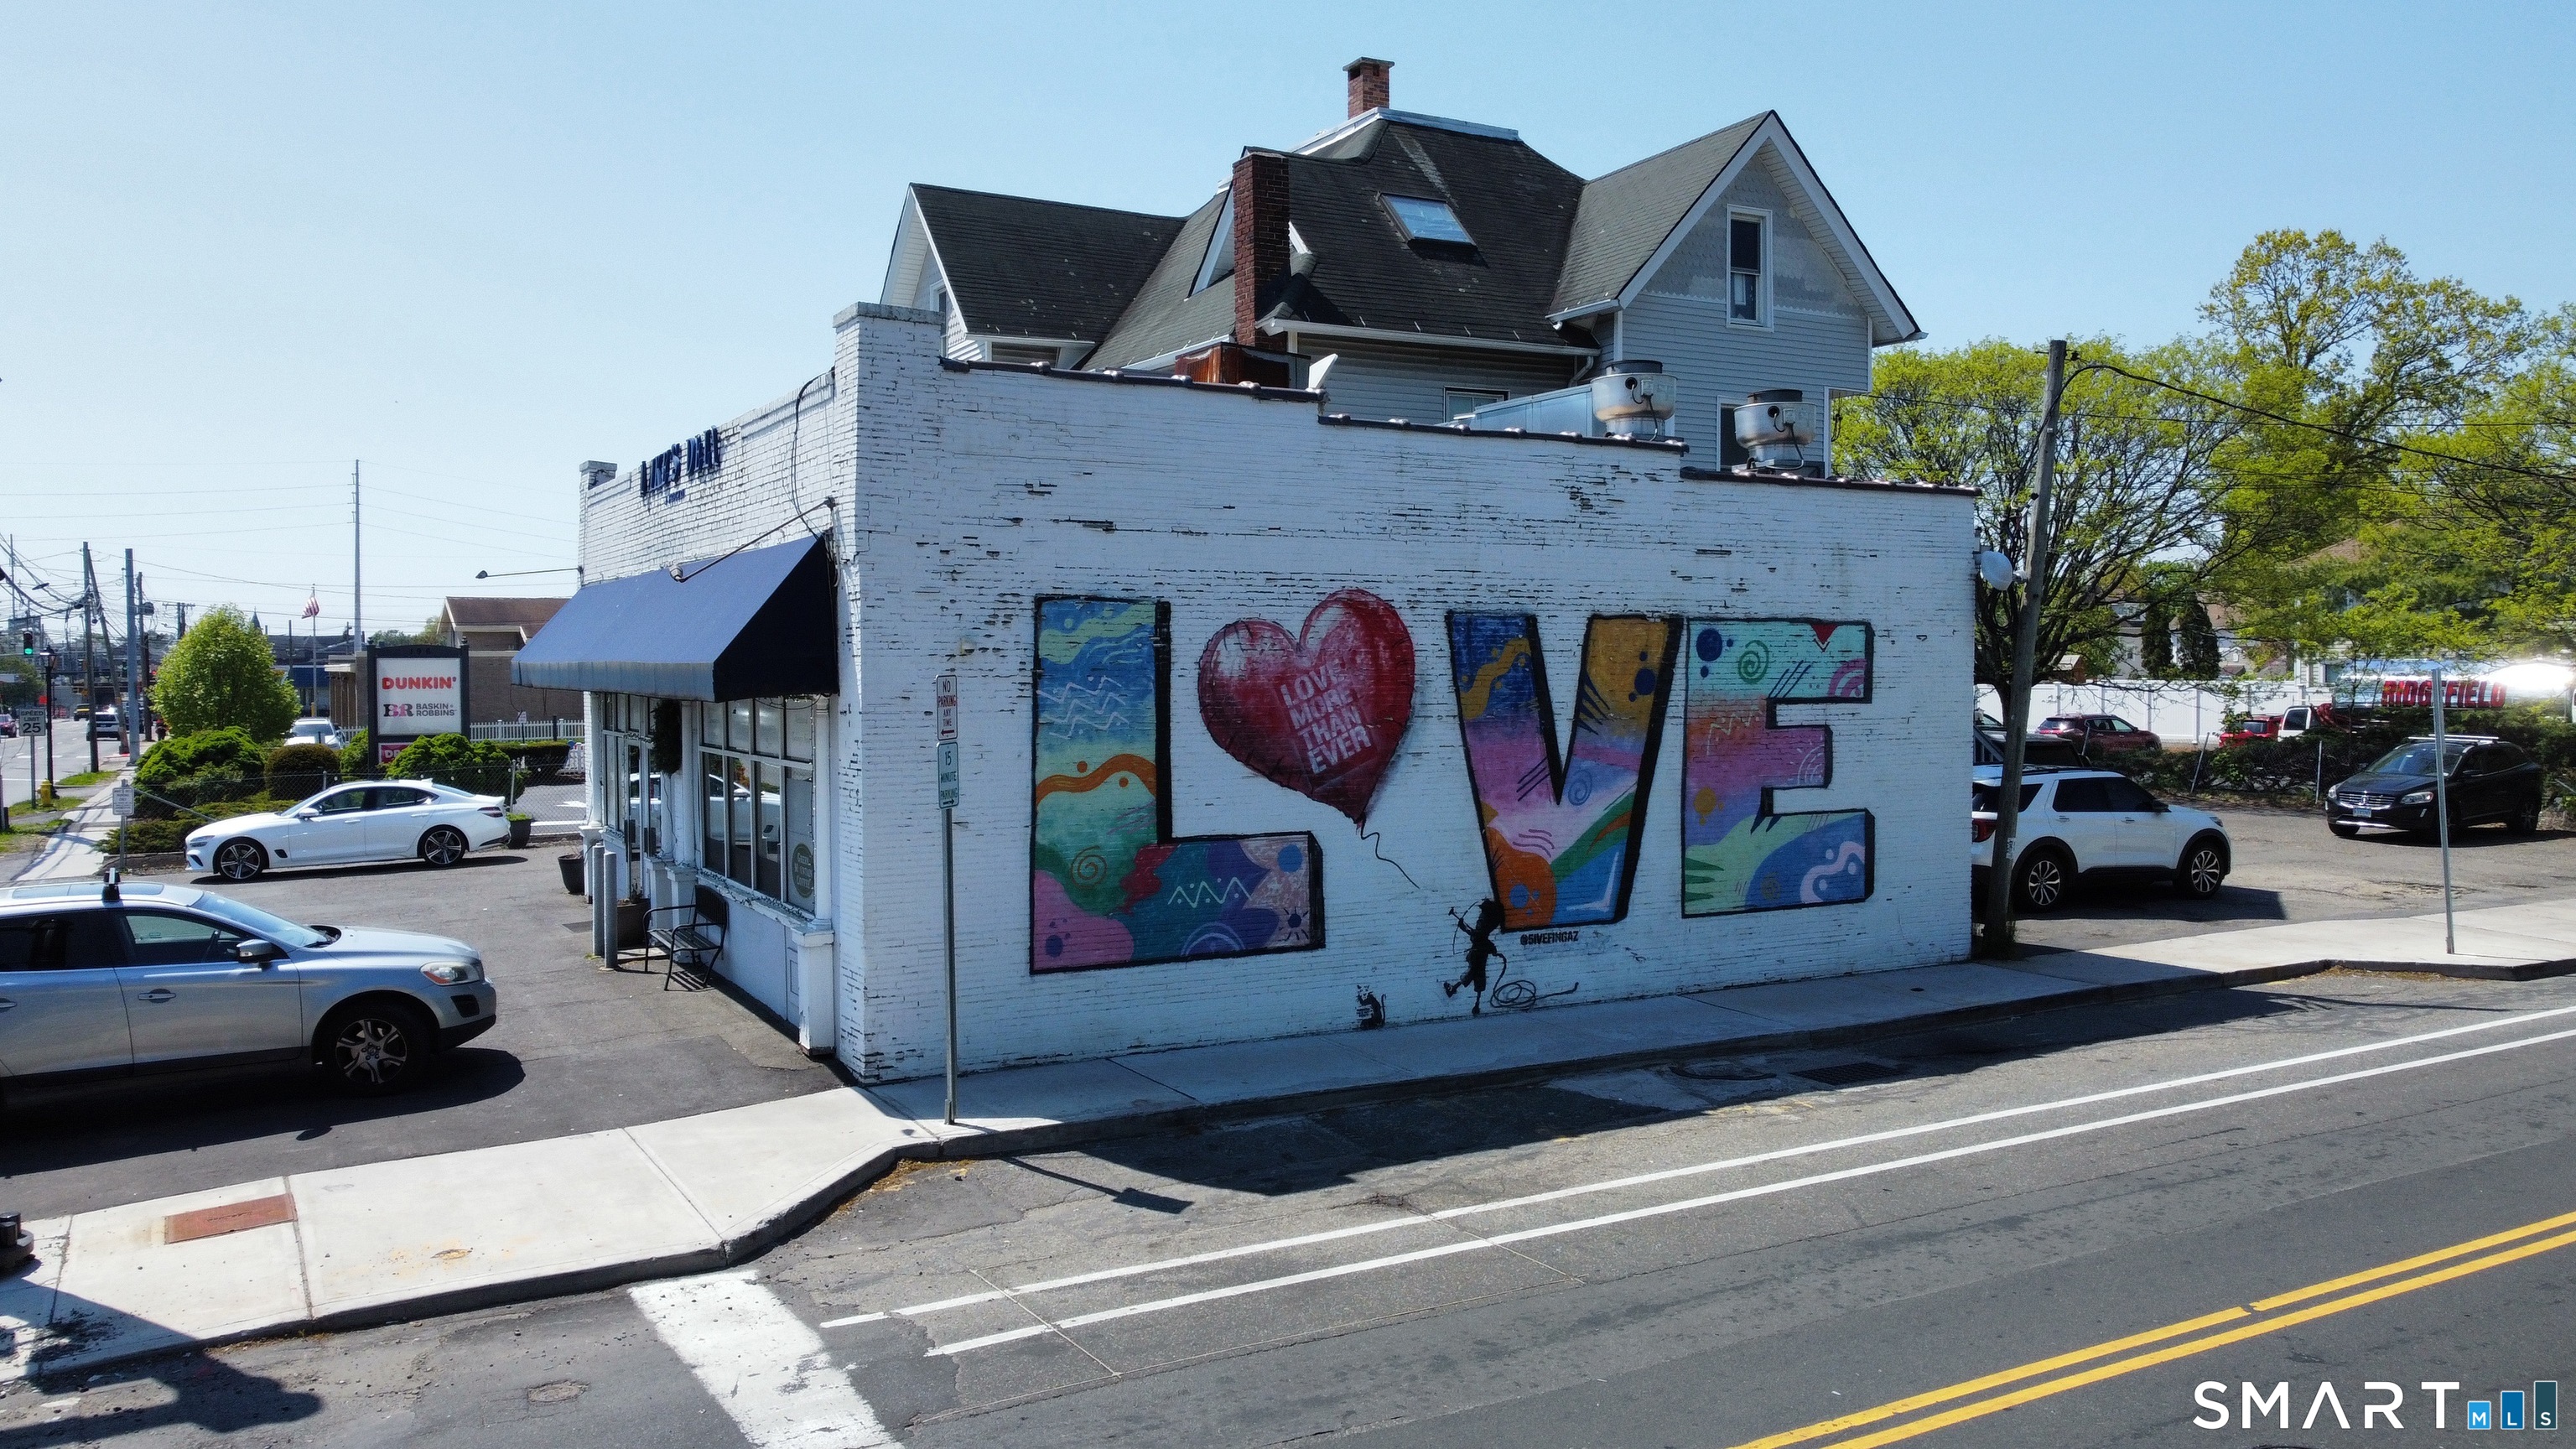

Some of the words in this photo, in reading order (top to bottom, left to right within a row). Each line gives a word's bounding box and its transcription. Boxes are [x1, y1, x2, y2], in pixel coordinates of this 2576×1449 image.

[382, 676, 457, 690] DUNKIN'
[943, 680, 951, 693] NO
[1280, 660, 1346, 708] LOVE
[938, 694, 957, 708] PARKING
[2381, 680, 2508, 709] RIDGFIELD
[383, 703, 414, 717] BR
[943, 709, 952, 717] ANY
[1289, 688, 1354, 730] MORE
[23, 723, 41, 734] 25
[943, 718, 952, 727] TIME
[1299, 706, 1363, 750] THAN
[1306, 724, 1372, 775] EVER
[945, 750, 952, 766] 15
[940, 771, 957, 784] MINUTE
[940, 787, 958, 801] PARKING
